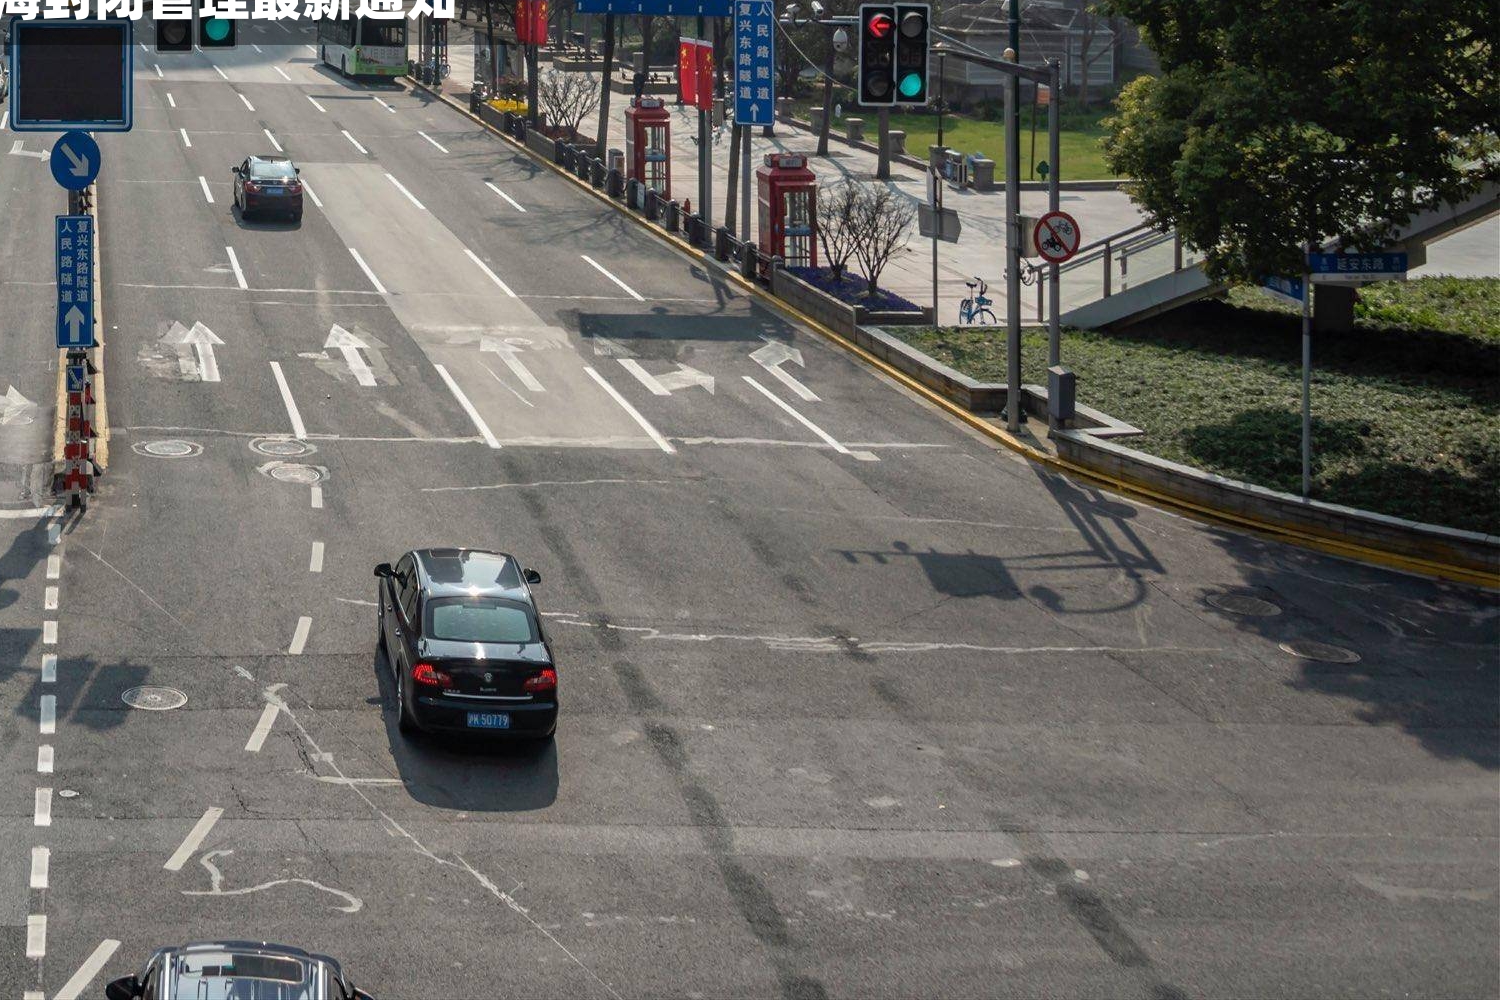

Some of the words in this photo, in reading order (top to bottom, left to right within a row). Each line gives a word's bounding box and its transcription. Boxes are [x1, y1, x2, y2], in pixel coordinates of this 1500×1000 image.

[739, 3, 752, 99] 复兴东路隧道
[757, 3, 769, 99] 人民路隧道
[60, 221, 73, 303] 人民路隧道
[76, 220, 89, 303] 复兴东路隧道
[1337, 257, 1384, 271] 延安东路
